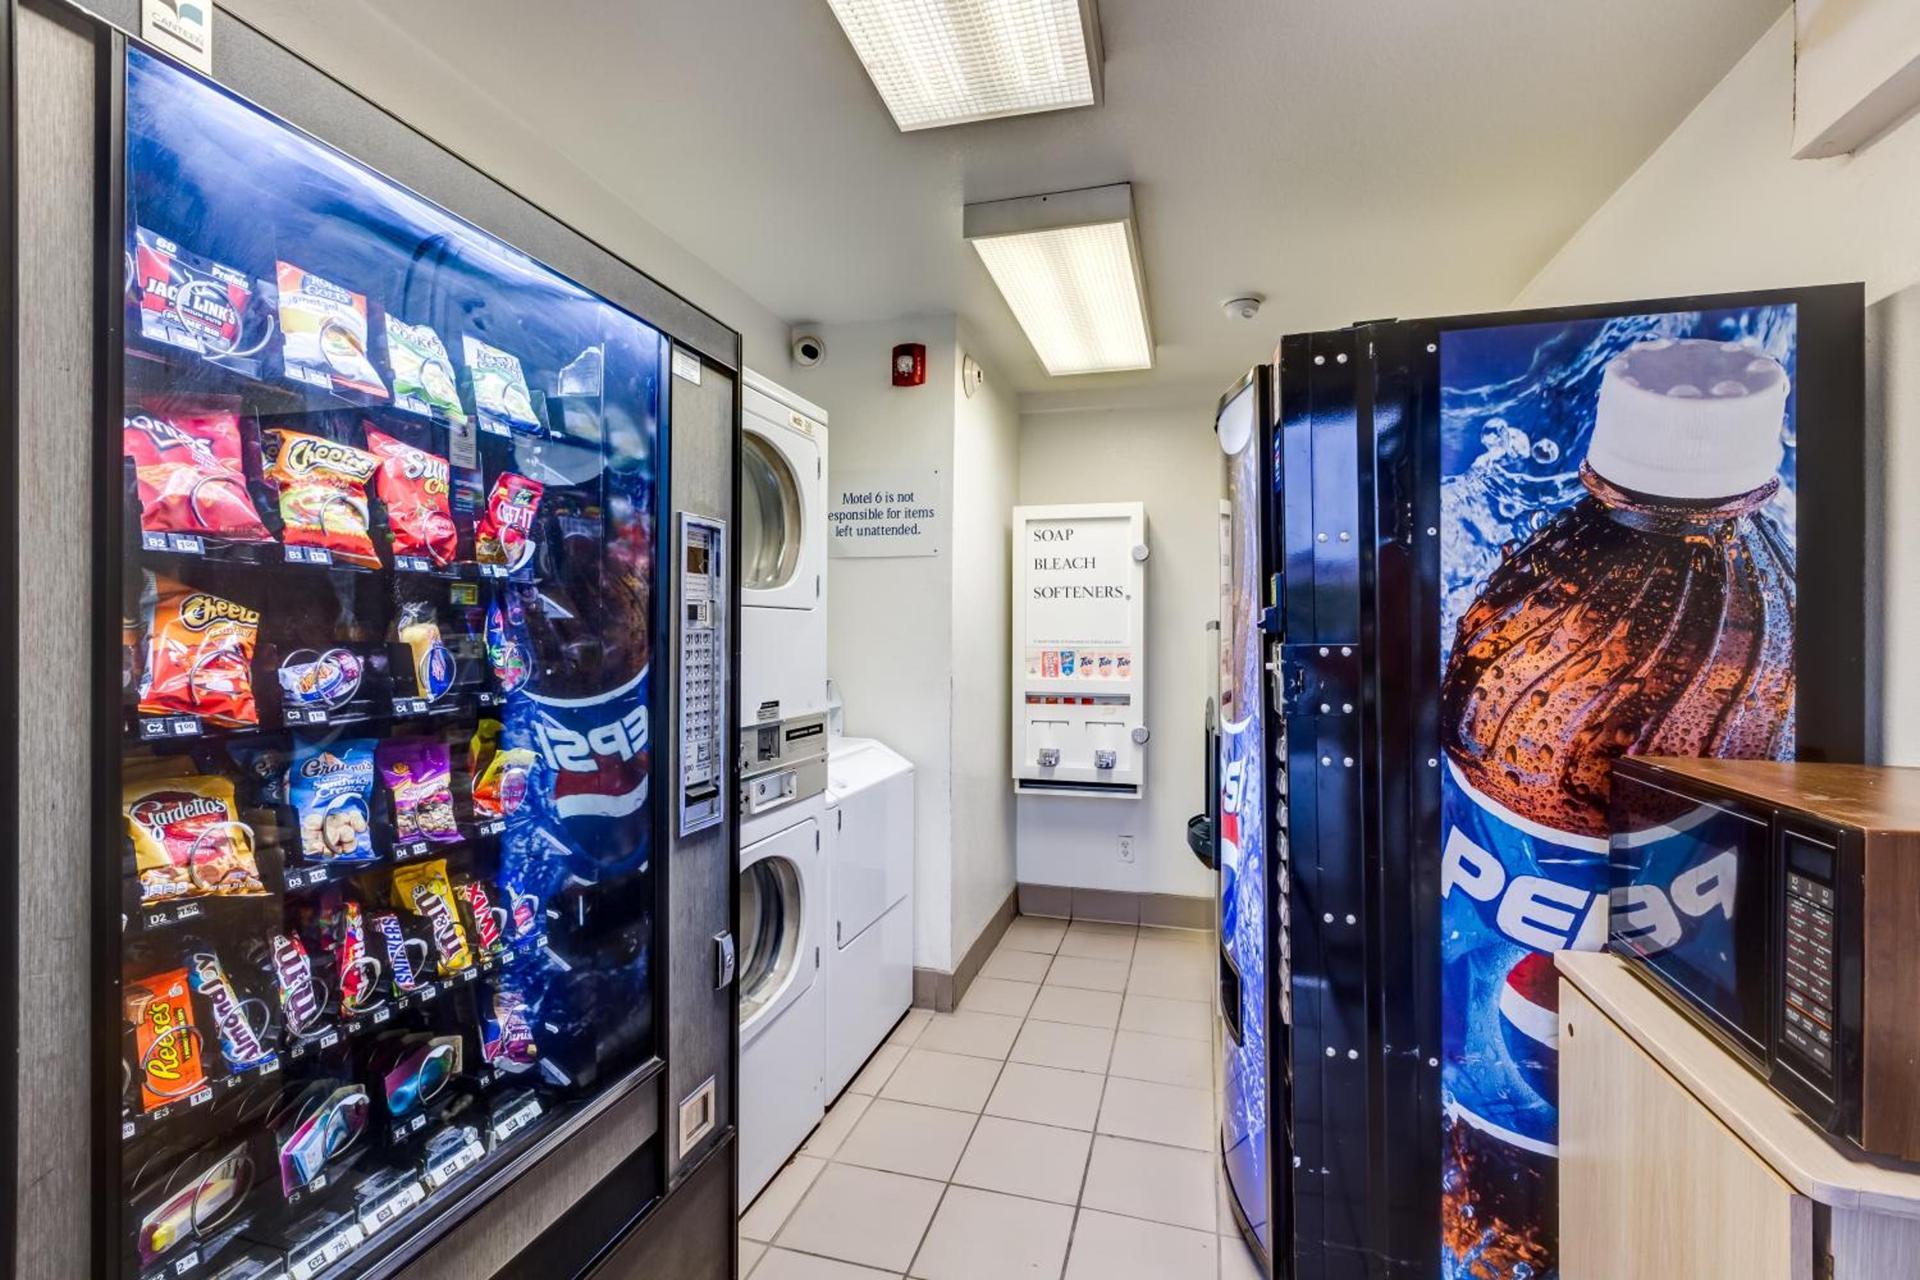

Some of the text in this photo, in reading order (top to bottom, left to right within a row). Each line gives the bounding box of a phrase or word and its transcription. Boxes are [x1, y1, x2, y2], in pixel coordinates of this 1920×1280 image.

[842, 491, 914, 504] Motel 6 is not
[828, 507, 935, 523] esponsible for items
[835, 523, 921, 537] left unattended.
[1033, 529, 1074, 541] SOAP
[1034, 557, 1096, 570] BLEACH
[1033, 586, 1124, 599] SOFTENERS
[184, 596, 260, 627] Cheeto
[147, 723, 164, 733] C2
[150, 913, 167, 924] D2
[146, 1001, 182, 1080] Reese's
[154, 1107, 170, 1120] E3
[309, 1252, 326, 1269] G2
